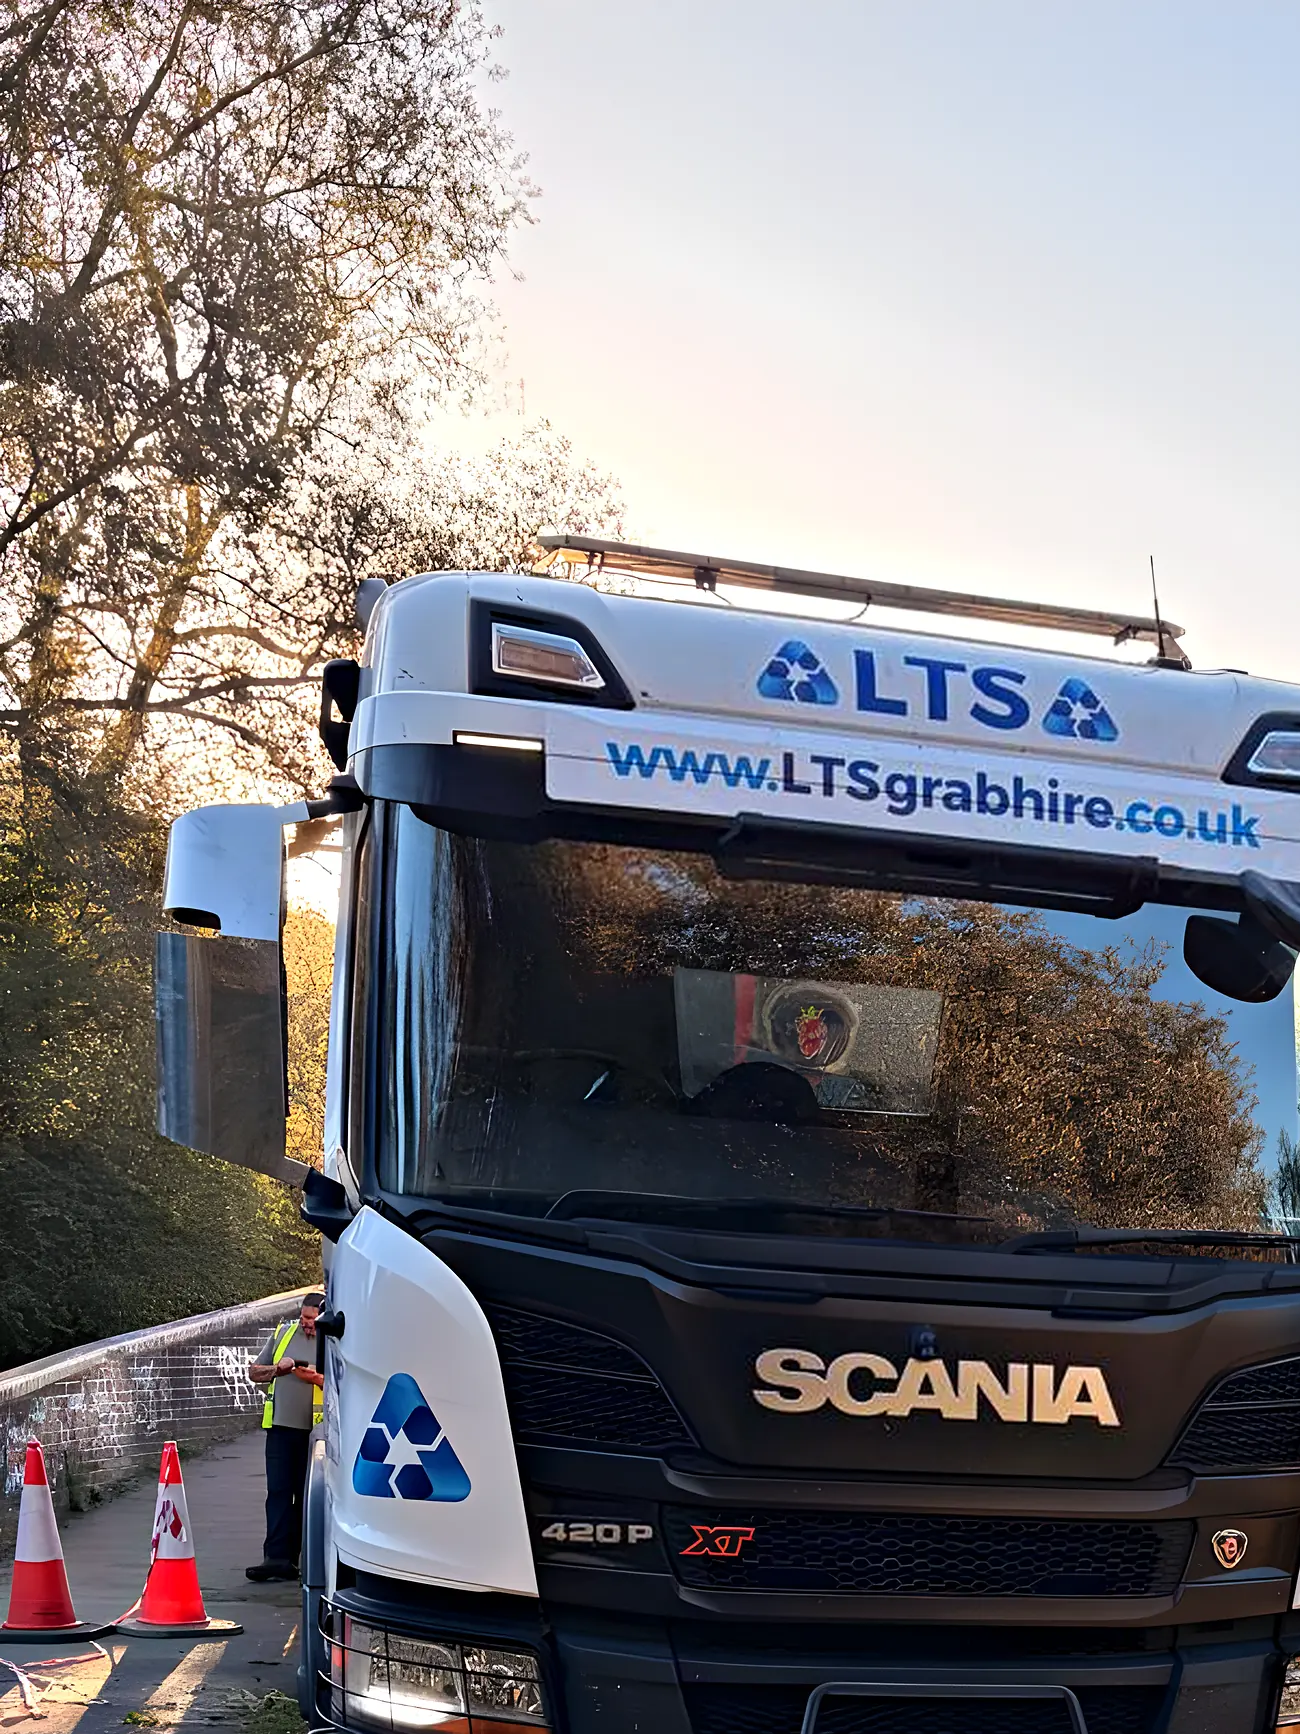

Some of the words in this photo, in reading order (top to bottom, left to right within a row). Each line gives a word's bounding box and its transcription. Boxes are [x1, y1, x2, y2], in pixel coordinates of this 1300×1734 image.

[853, 649, 1030, 732] LTS
[605, 740, 1261, 849] www.LTSgrabhire.co.uk
[752, 1347, 1121, 1427] SCANIA
[541, 1522, 622, 1544] 420
[627, 1524, 654, 1545] P
[679, 1524, 756, 1556] XT
